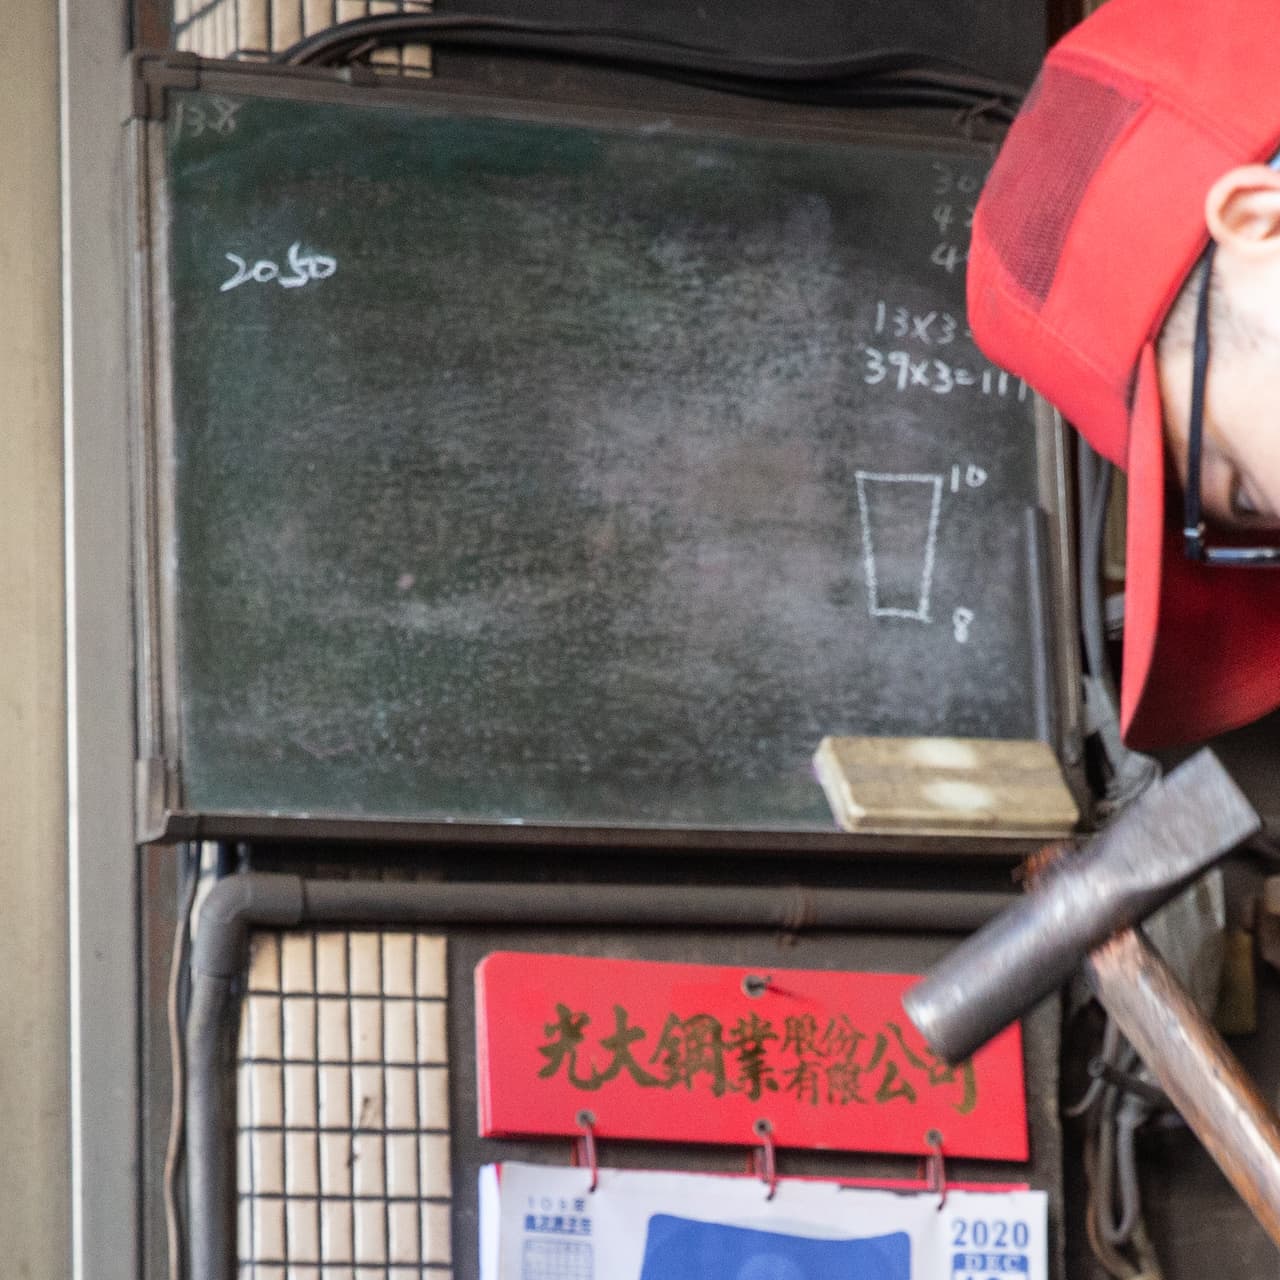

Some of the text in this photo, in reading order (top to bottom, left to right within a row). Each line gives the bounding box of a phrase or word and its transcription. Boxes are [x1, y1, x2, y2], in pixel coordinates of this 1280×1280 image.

[220, 240, 338, 292] 2050
[950, 464, 988, 493] 10
[952, 606, 975, 644] 8
[952, 1219, 1030, 1248] 2020
